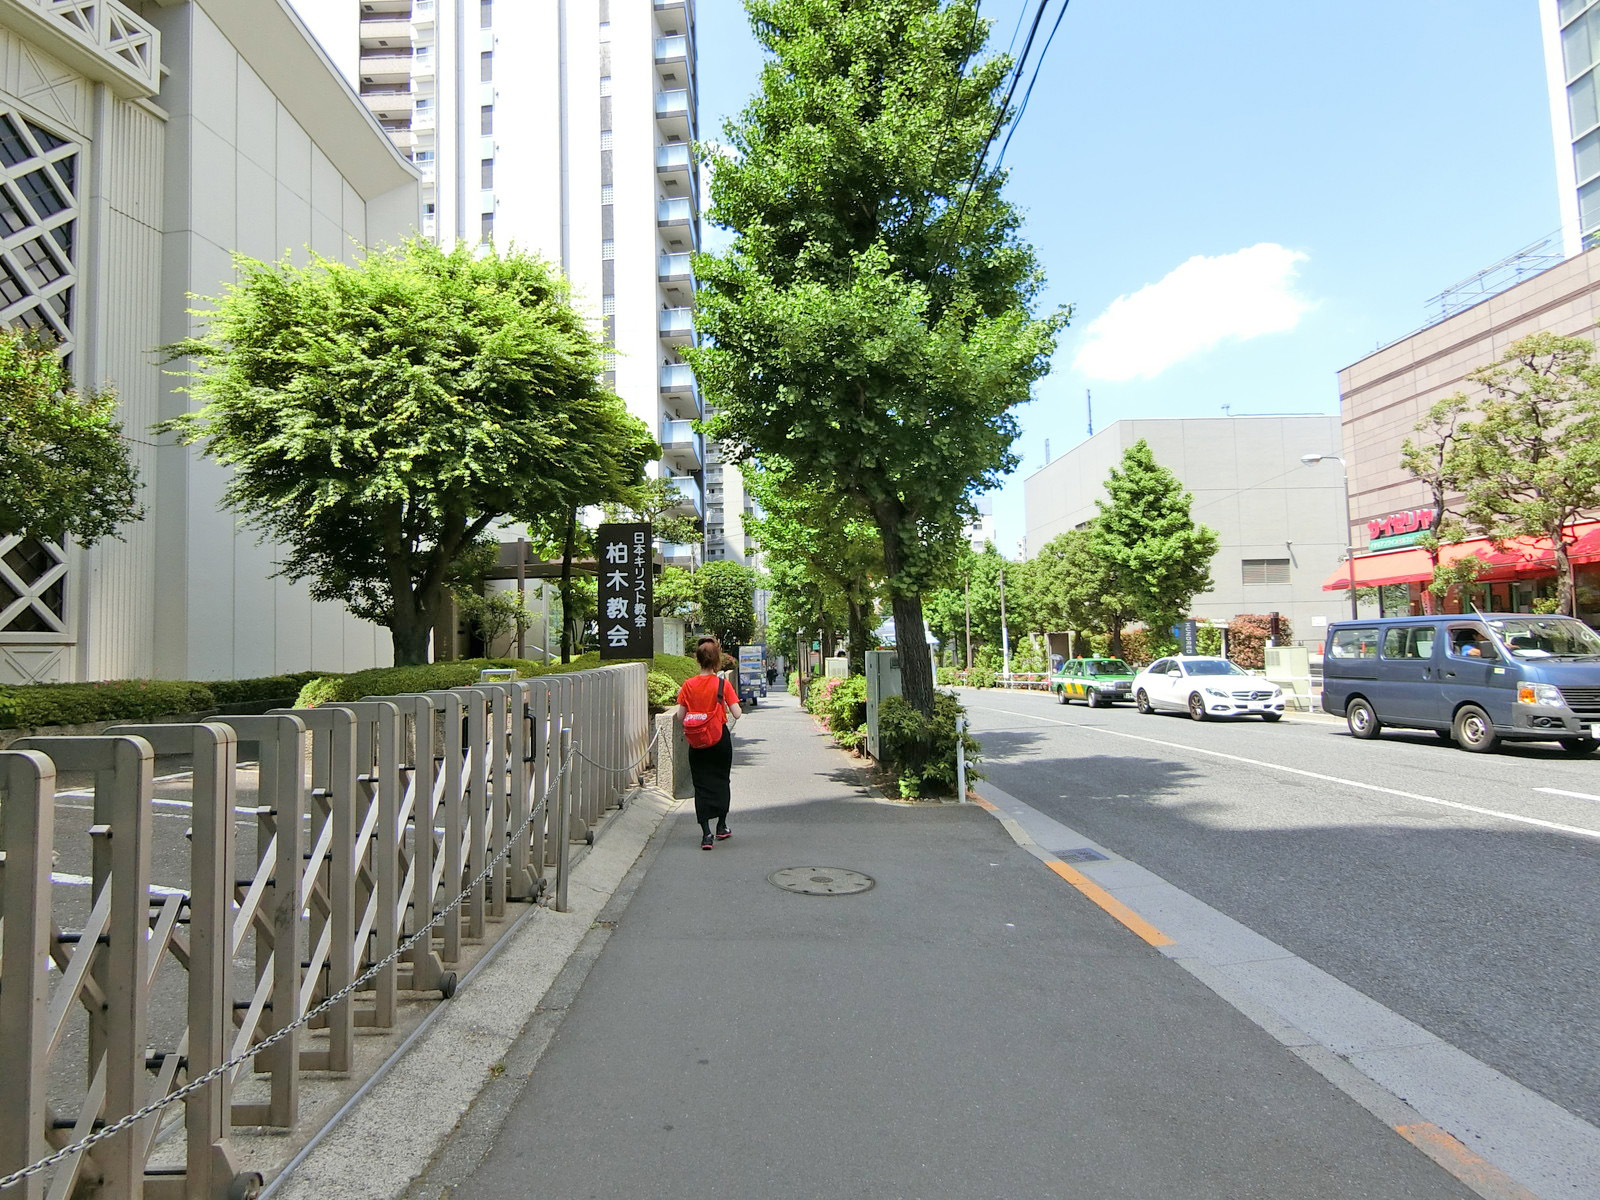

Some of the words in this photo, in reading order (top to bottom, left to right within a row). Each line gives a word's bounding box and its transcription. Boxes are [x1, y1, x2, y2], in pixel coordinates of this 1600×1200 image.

[1368, 509, 1434, 539] サイゼリヤ
[606, 542, 630, 647] 柏木教会
[633, 532, 647, 628] 日本キリスト教会
[1184, 622, 1193, 654] HUNDRED
